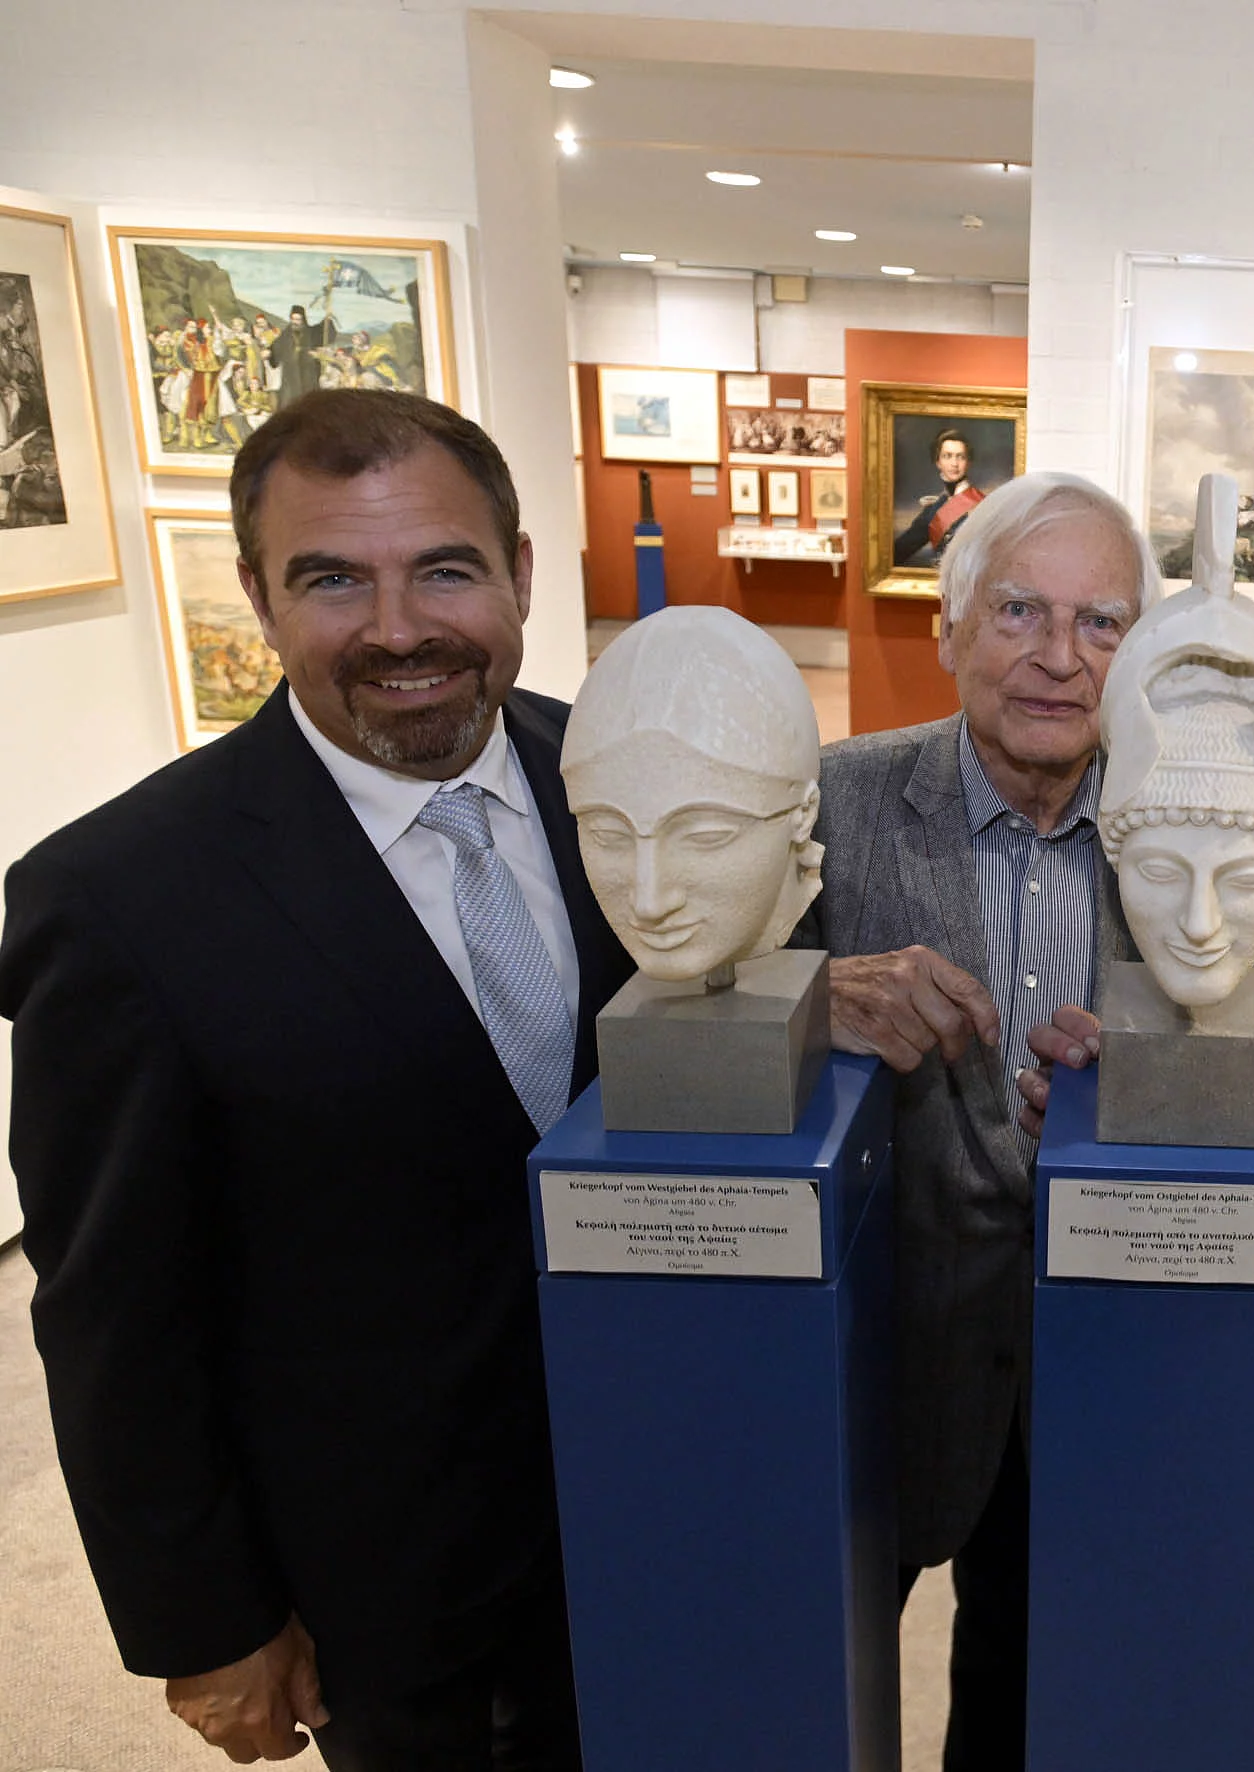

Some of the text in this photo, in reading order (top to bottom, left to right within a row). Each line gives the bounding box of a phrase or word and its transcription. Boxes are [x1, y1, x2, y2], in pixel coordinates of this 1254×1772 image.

[569, 1181, 788, 1198] Kriegerkopf vom Westgiebel des Aphaia-Tempels
[1080, 1187, 1133, 1201] Kriegerkopf
[1135, 1192, 1154, 1200] vom
[1156, 1191, 1199, 1203] Ostgiebel
[1201, 1193, 1216, 1202] des
[623, 1197, 640, 1205] von
[671, 1198, 686, 1206] um
[687, 1198, 706, 1206] 480
[575, 1219, 617, 1233] Κεφαλή
[675, 1222, 695, 1232] από
[697, 1224, 709, 1232] το
[1070, 1224, 1110, 1239] Κεφαλή
[1166, 1230, 1186, 1240] από
[1189, 1231, 1200, 1240] το
[628, 1233, 647, 1242] του
[677, 1234, 695, 1245] της
[687, 1249, 699, 1257] το
[701, 1248, 719, 1257] 480
[1129, 1241, 1148, 1250] του
[1177, 1242, 1195, 1253] της
[1184, 1256, 1197, 1265] το
[1198, 1256, 1216, 1265] 480
